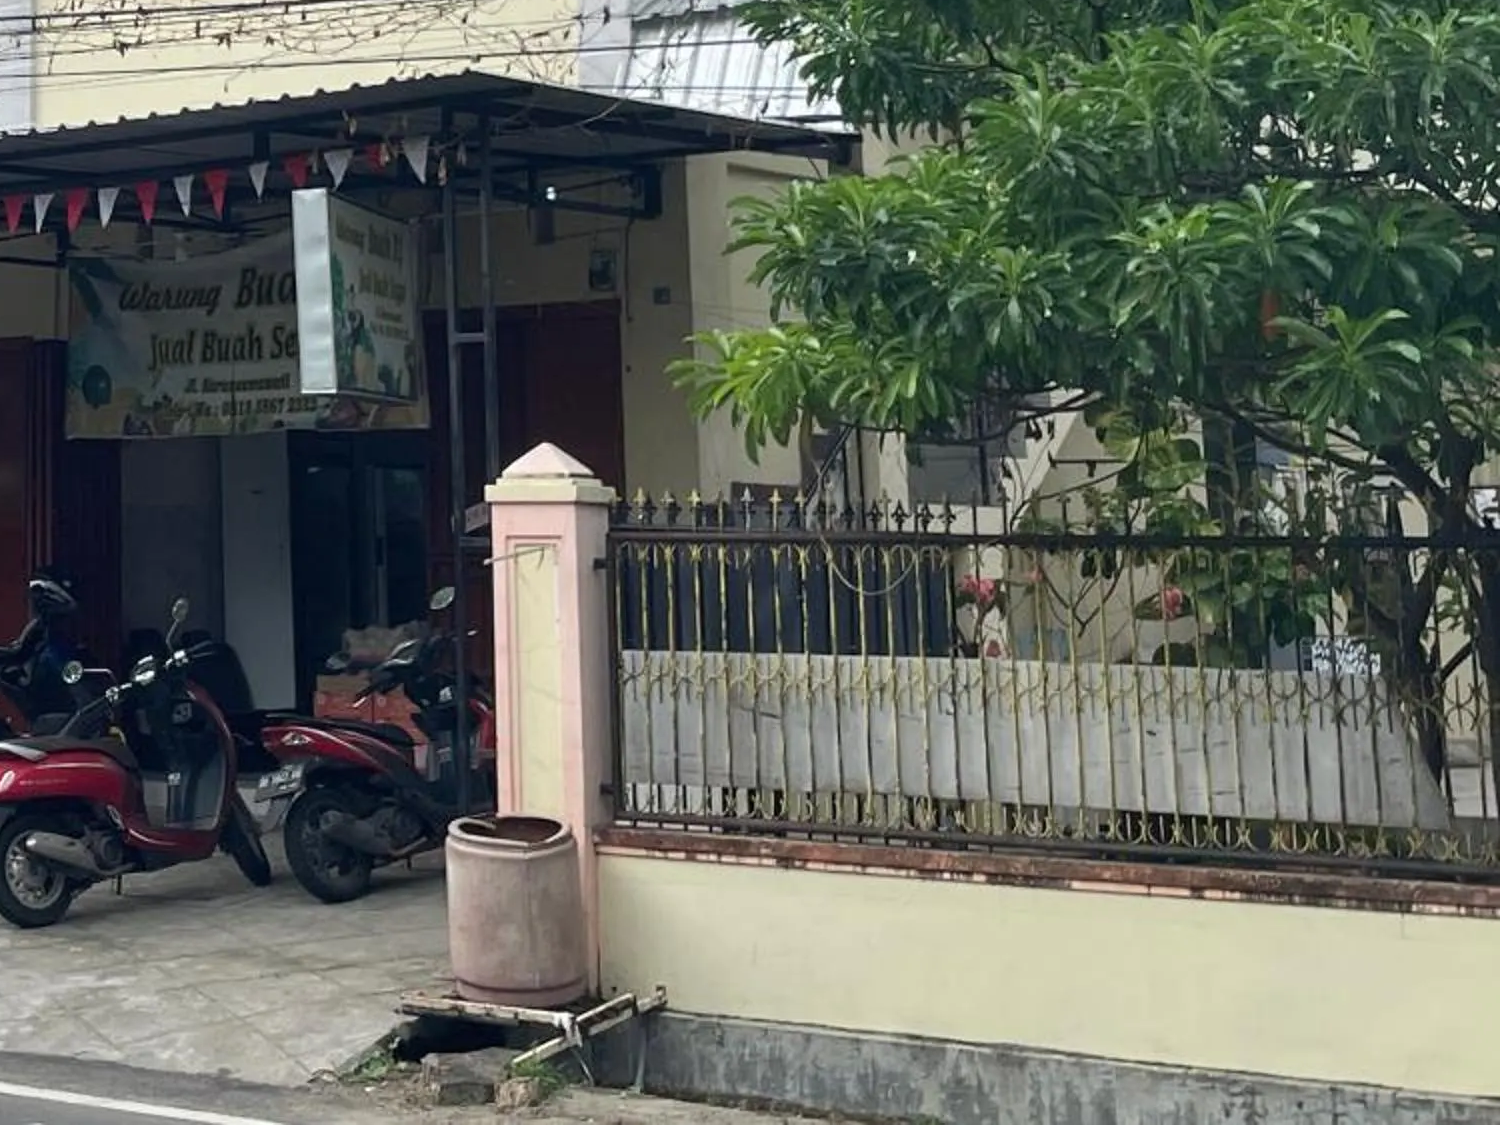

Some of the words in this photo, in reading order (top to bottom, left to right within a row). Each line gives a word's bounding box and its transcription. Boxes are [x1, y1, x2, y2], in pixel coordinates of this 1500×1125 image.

[119, 280, 223, 316] Warung
[234, 265, 296, 309] Bua
[148, 328, 197, 371] Jual
[202, 323, 264, 364] Buah
[269, 325, 299, 360] Se
